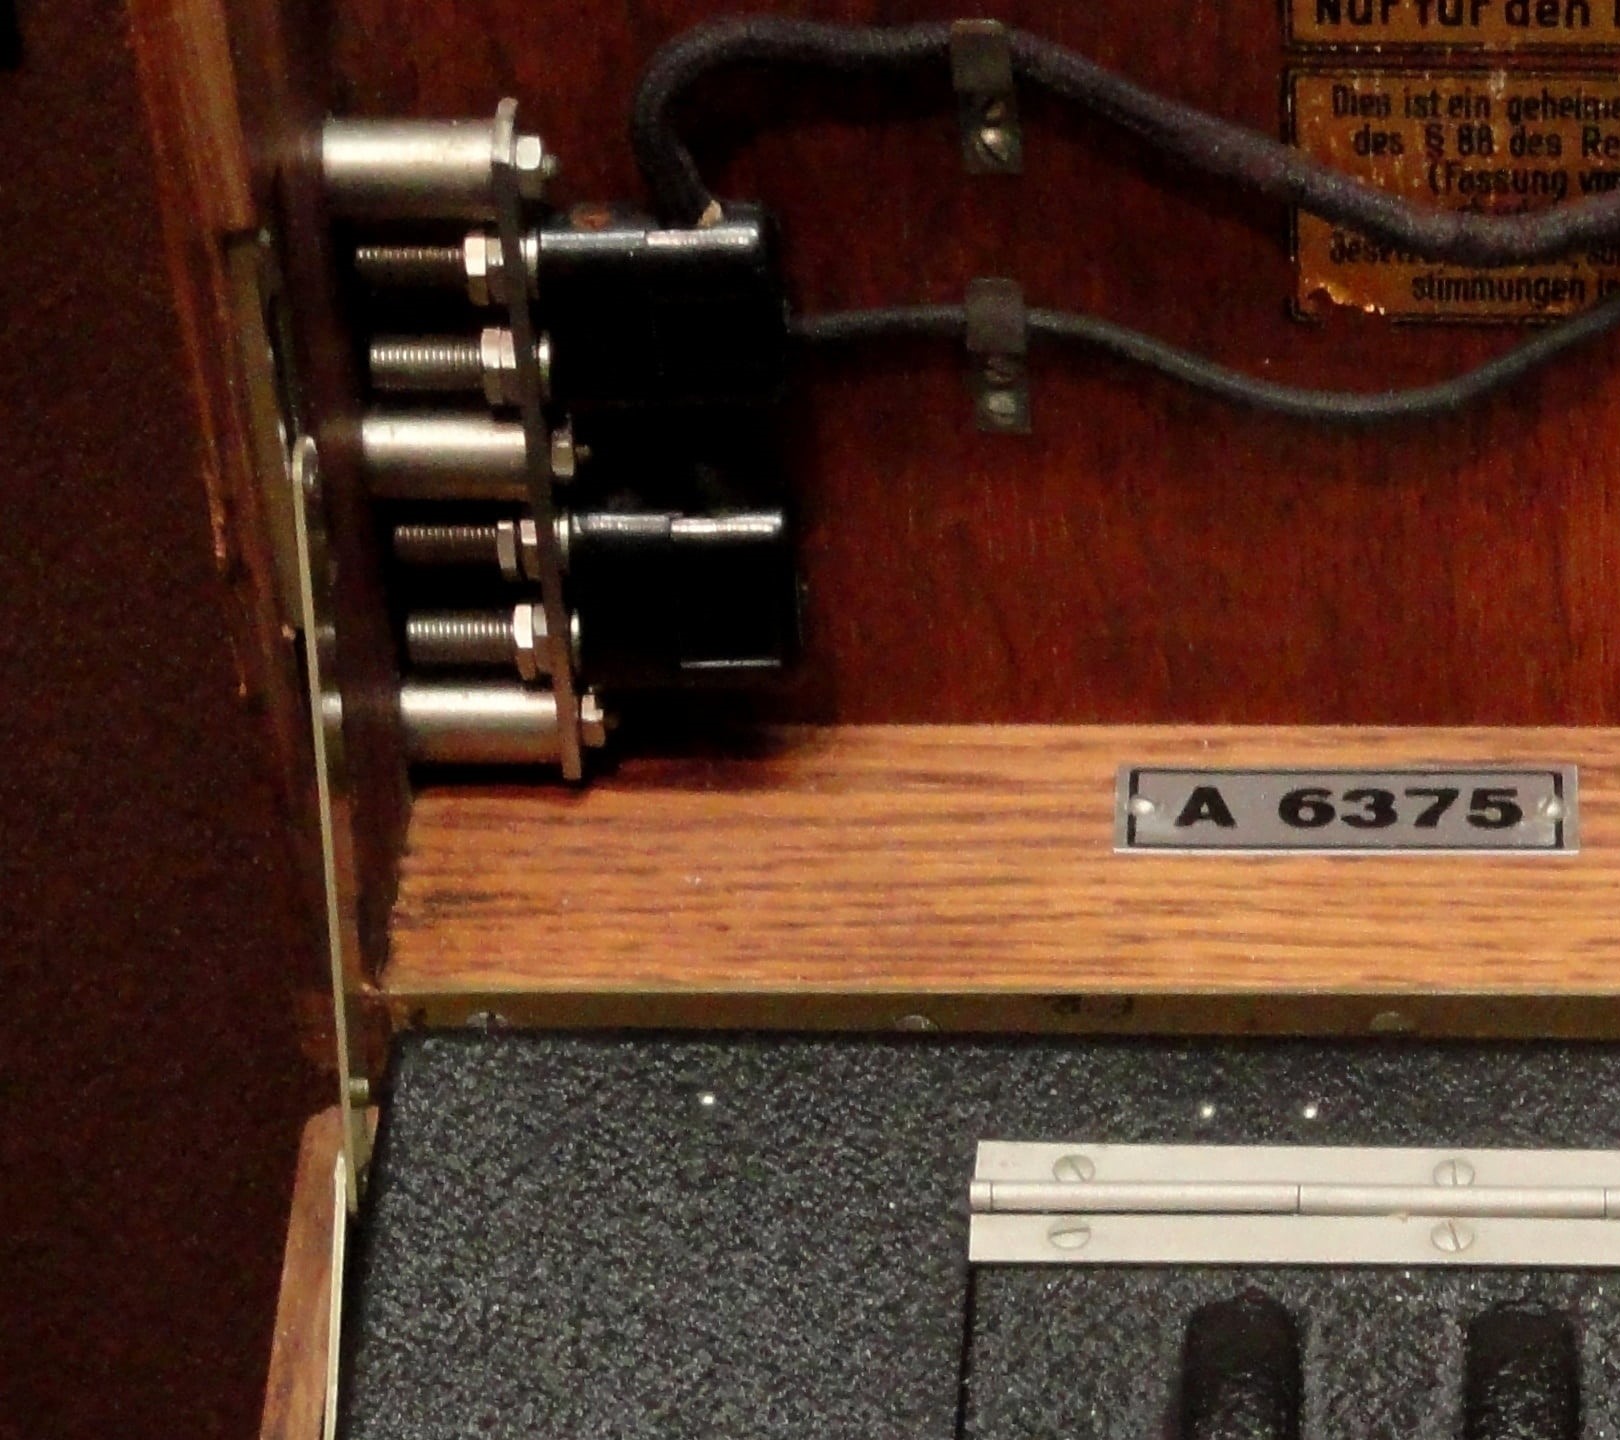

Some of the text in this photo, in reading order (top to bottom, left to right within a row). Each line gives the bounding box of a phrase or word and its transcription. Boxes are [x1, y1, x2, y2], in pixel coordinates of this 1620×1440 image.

[1447, 87, 1491, 119] ein
[1353, 123, 1404, 155] des
[1457, 122, 1493, 155] 88
[1509, 125, 1562, 157] des
[1173, 786, 1524, 829] A 6375
